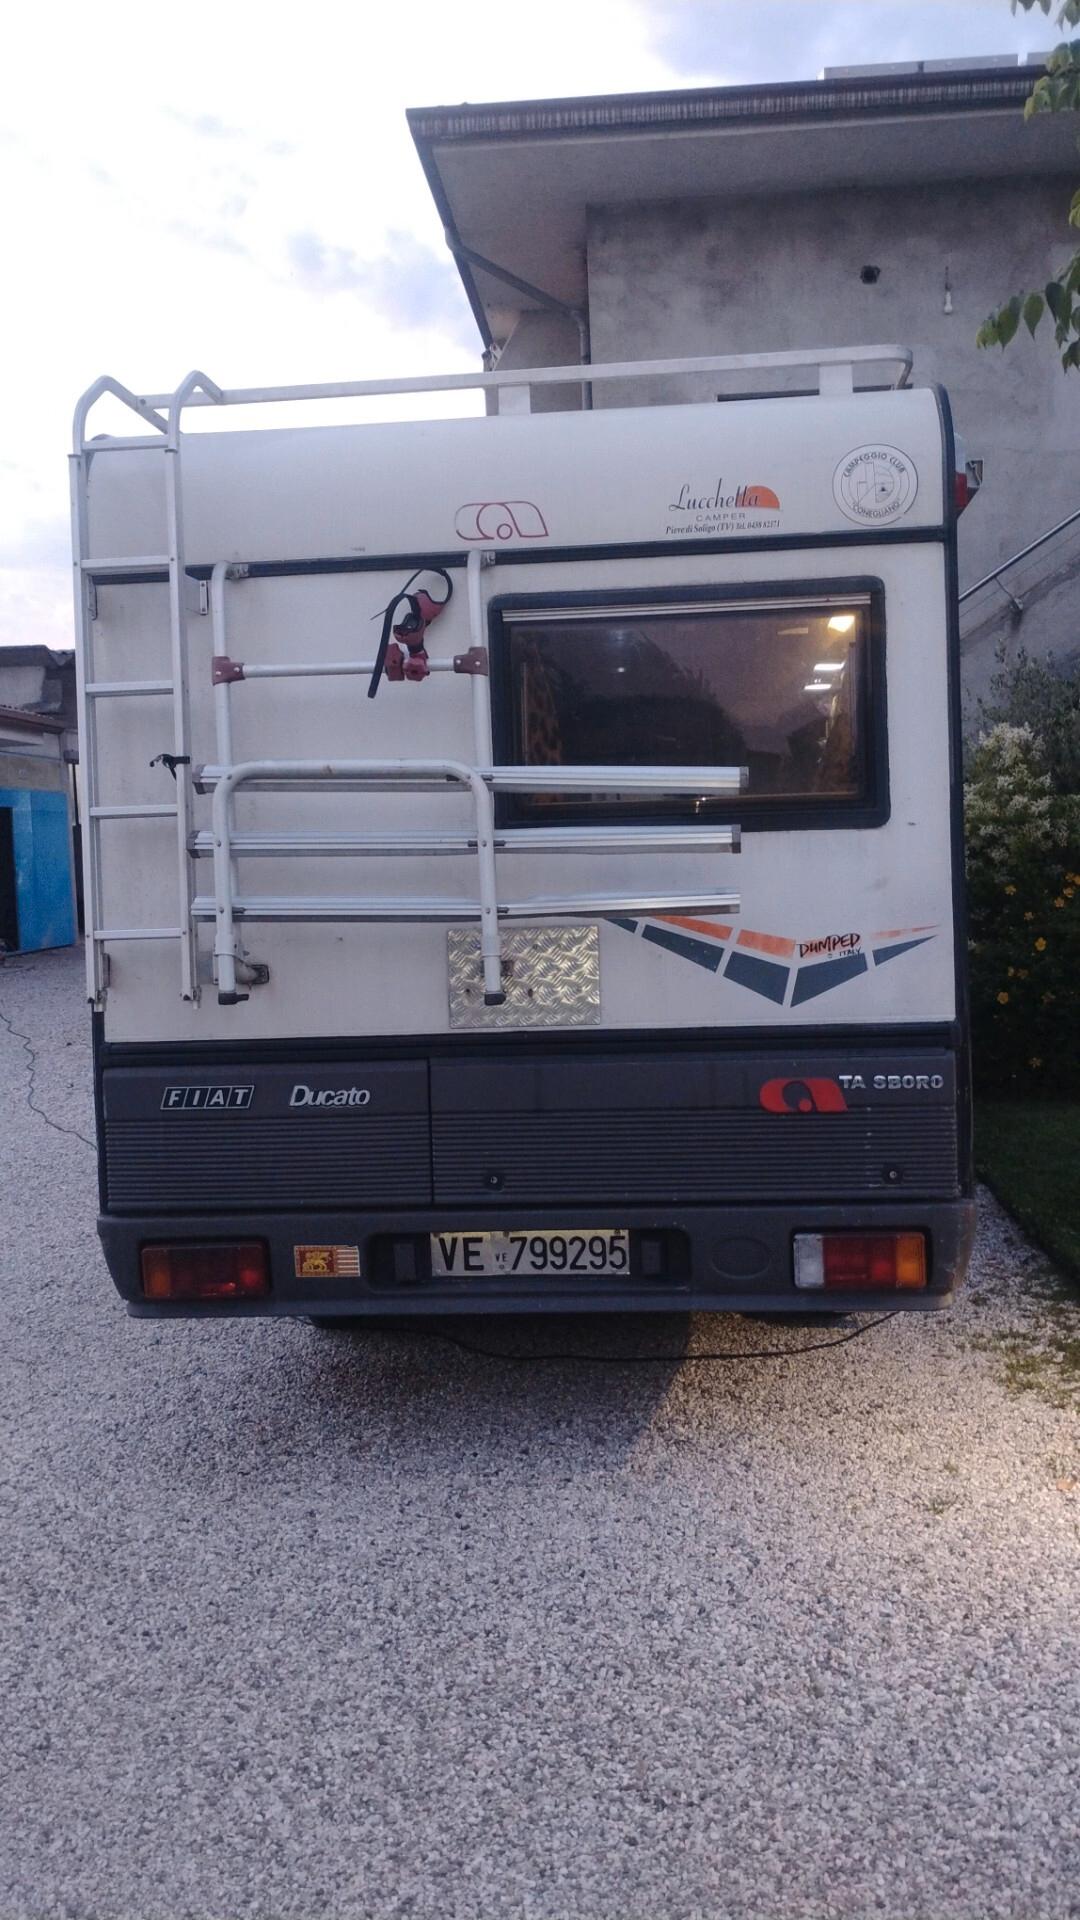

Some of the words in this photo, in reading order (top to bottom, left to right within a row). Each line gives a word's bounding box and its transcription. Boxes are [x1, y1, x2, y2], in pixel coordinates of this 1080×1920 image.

[668, 478, 759, 511] Lucchetta
[695, 512, 746, 521] CAMPER
[717, 521, 734, 532] (TV)
[797, 932, 861, 958] DUMPED
[839, 1075, 866, 1089] TA
[873, 1075, 944, 1089] SBORO
[164, 1087, 251, 1108] FIAT
[289, 1084, 371, 1107] Ducato
[439, 1236, 485, 1271] VE
[509, 1235, 627, 1271] 799295
[495, 1252, 508, 1263] VE
